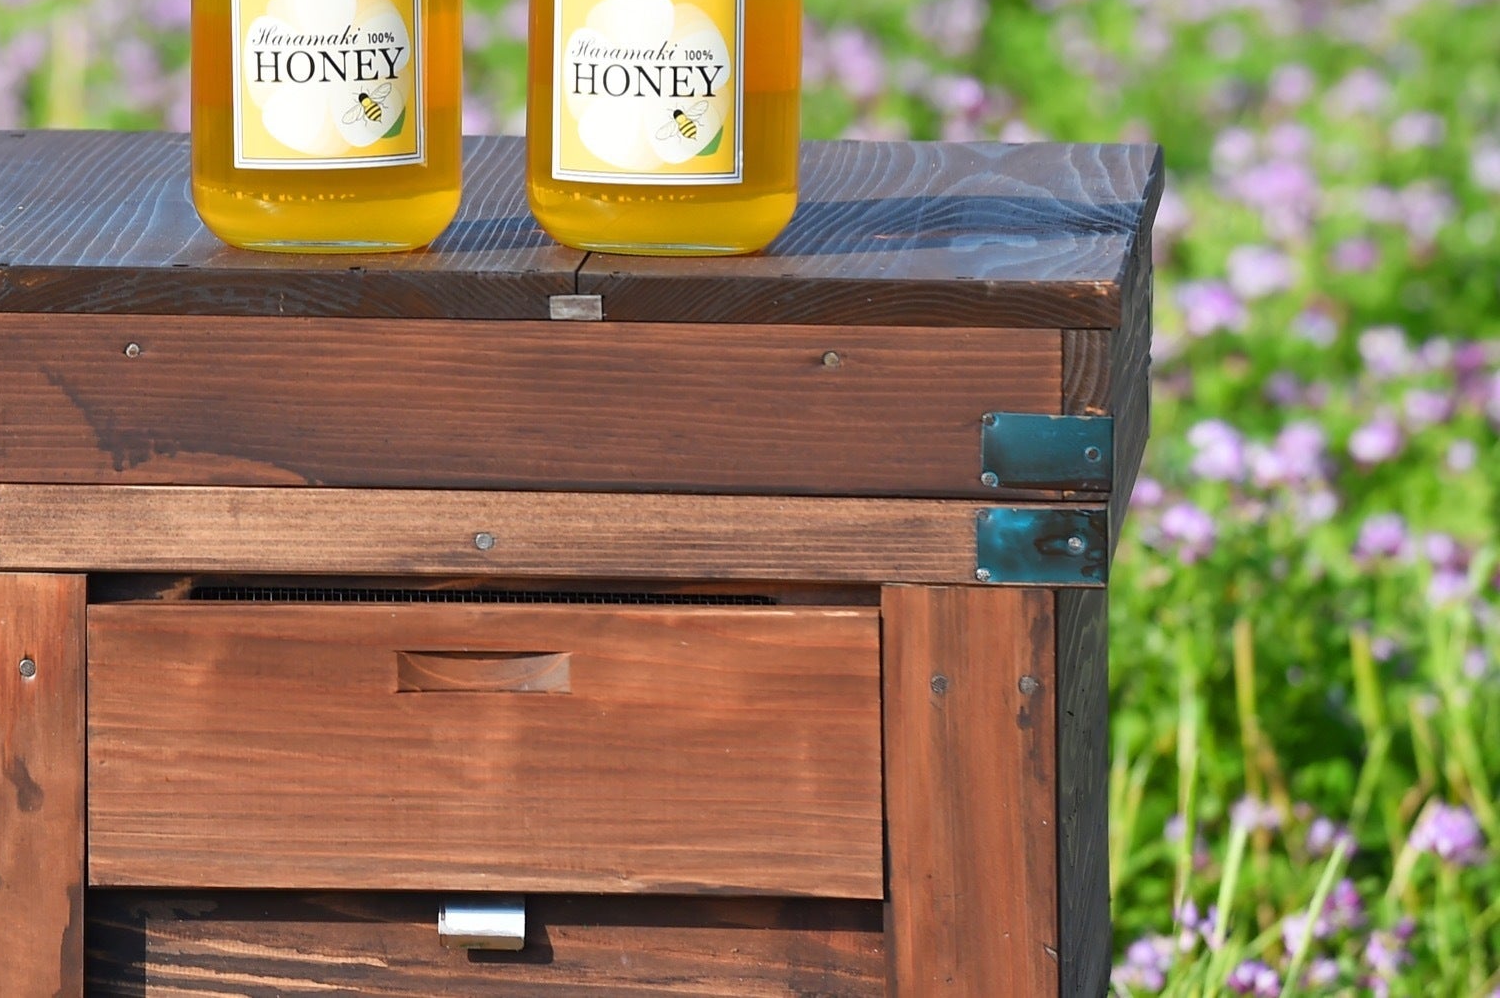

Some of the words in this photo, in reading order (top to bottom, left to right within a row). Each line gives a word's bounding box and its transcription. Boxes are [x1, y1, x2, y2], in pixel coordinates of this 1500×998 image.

[252, 24, 361, 46] Haramaki
[367, 31, 395, 45] 100%
[571, 38, 678, 60] Haramaki
[684, 48, 714, 62] 100%
[254, 47, 404, 83] HONEY
[572, 62, 724, 97] HONEY
